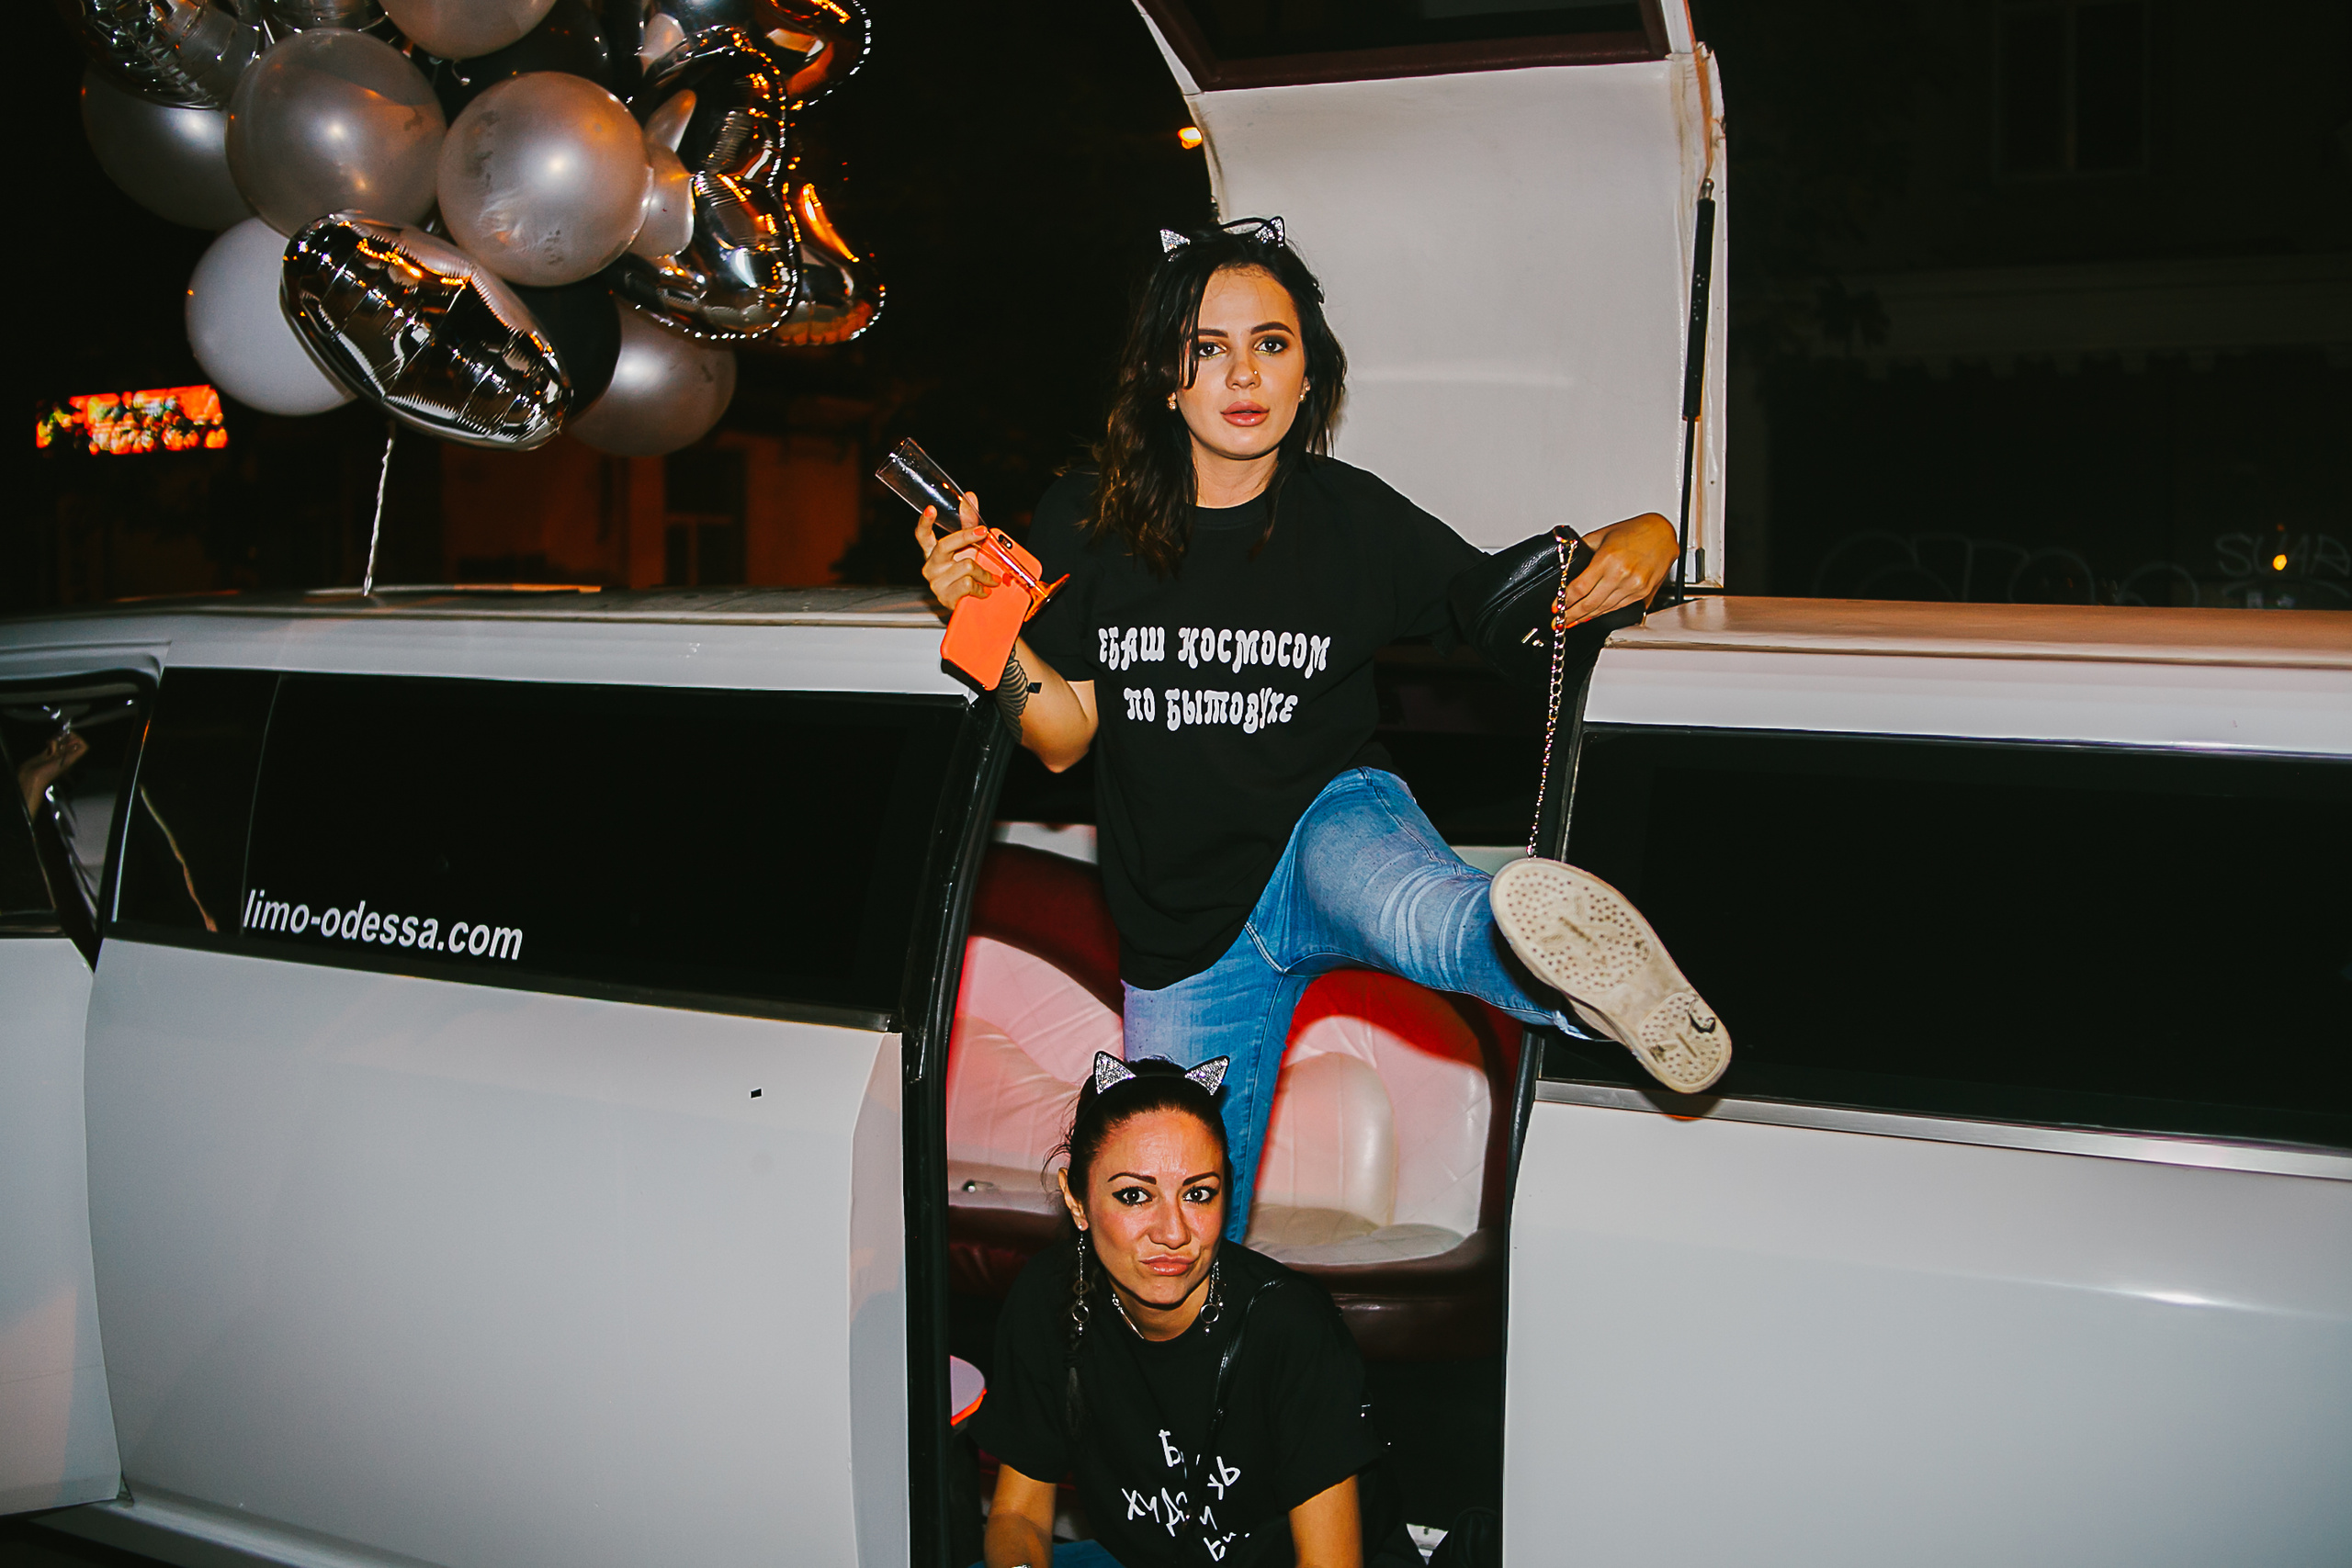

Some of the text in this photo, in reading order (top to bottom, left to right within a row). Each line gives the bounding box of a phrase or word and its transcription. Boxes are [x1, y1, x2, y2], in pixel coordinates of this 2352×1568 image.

[1098, 626, 1331, 679] ЕБАШ КОСМОСОМ
[1123, 687, 1298, 734] ПО БЫТОВУХЕ
[243, 889, 523, 961] limo-odessa.com
